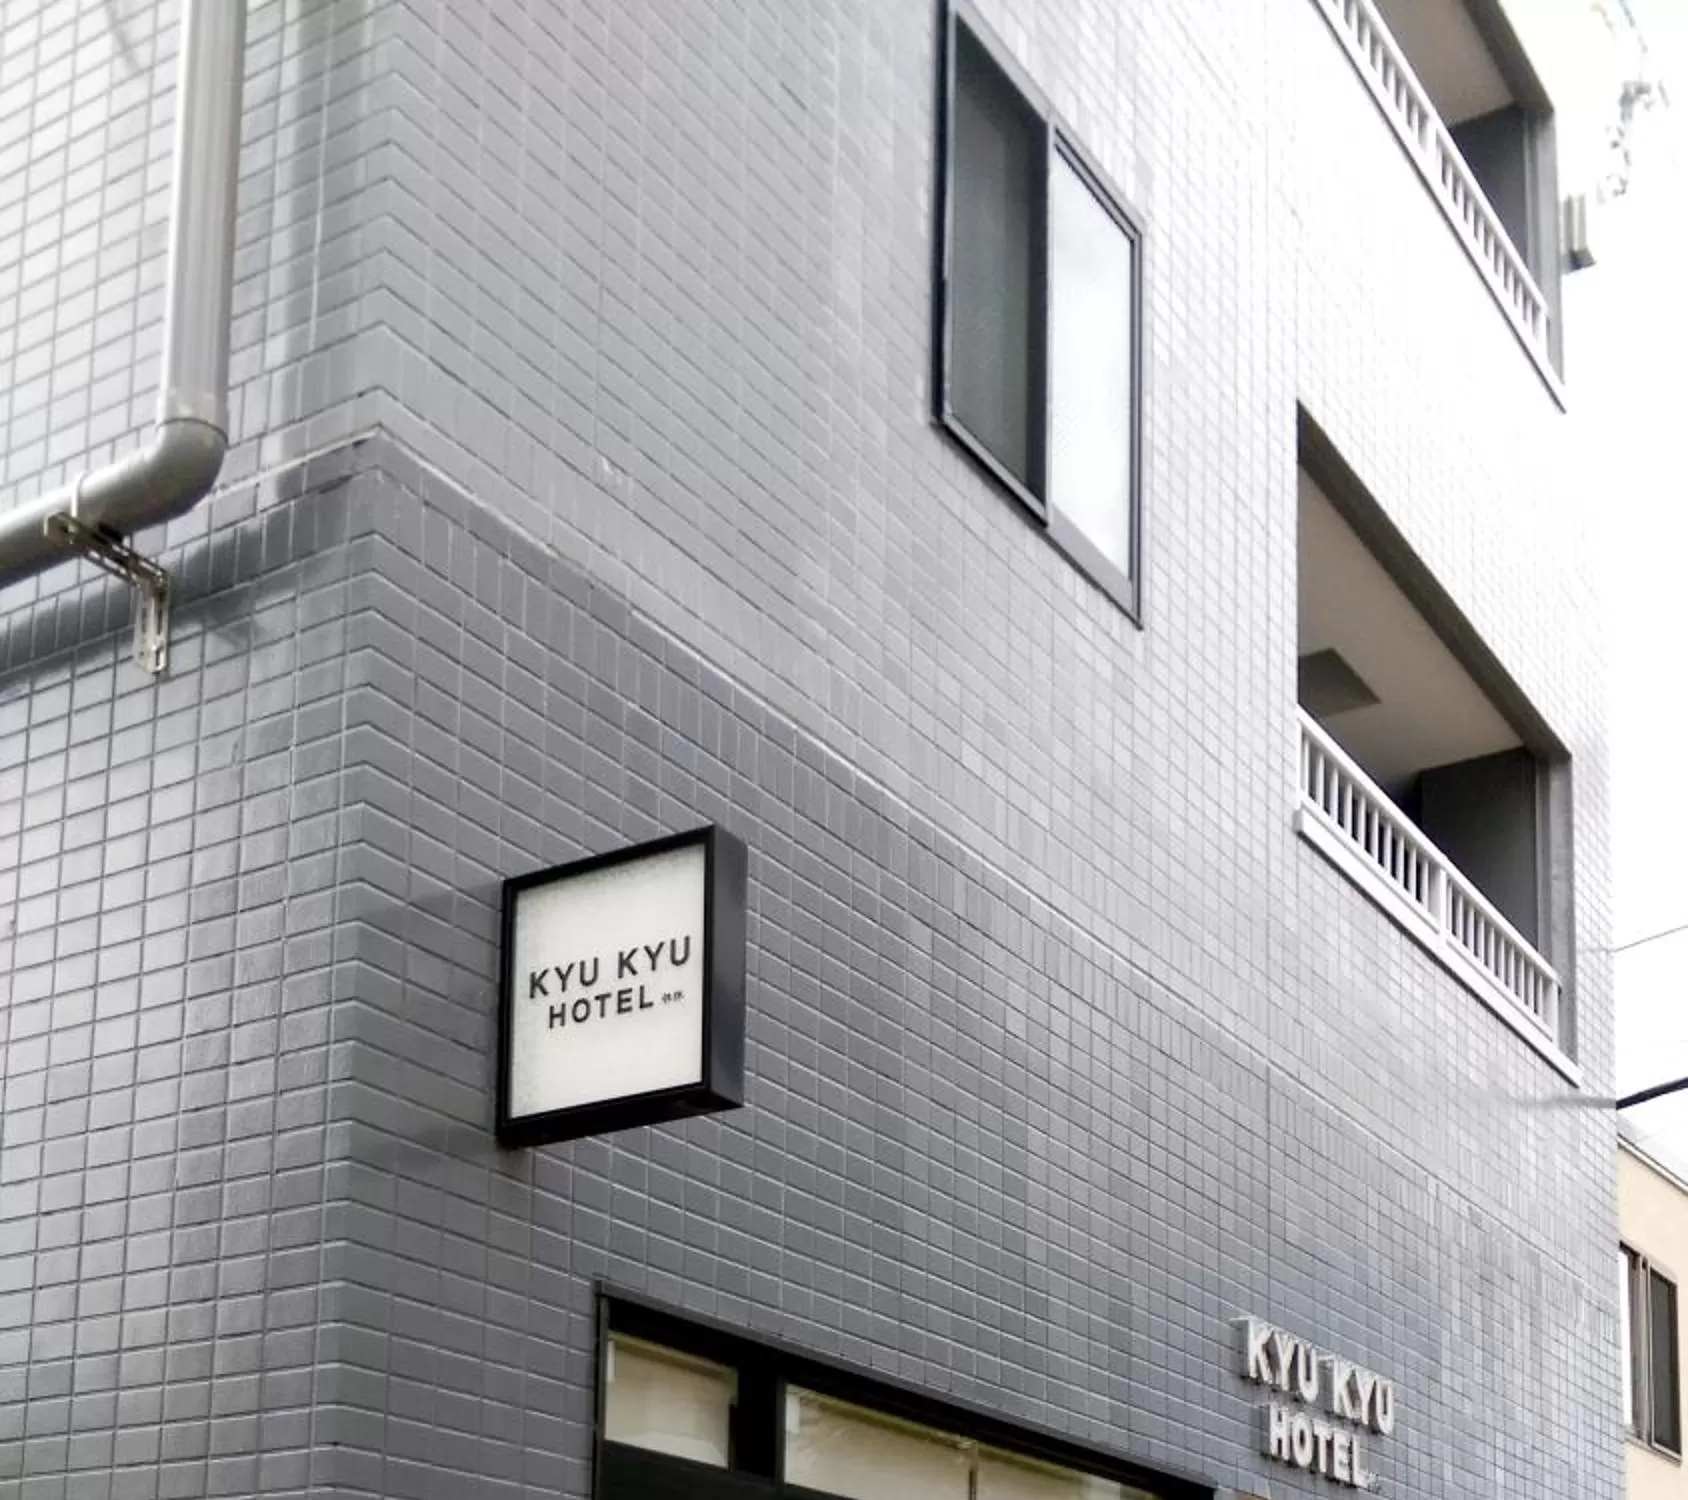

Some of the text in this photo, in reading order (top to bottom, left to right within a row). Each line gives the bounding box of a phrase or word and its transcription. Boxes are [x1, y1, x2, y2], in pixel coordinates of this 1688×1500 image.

[528, 935, 692, 1000] KYU KYU
[548, 984, 655, 1029] HOTEL
[1244, 1316, 1396, 1435] KYU KYU
[1266, 1401, 1370, 1489] HOTEL
